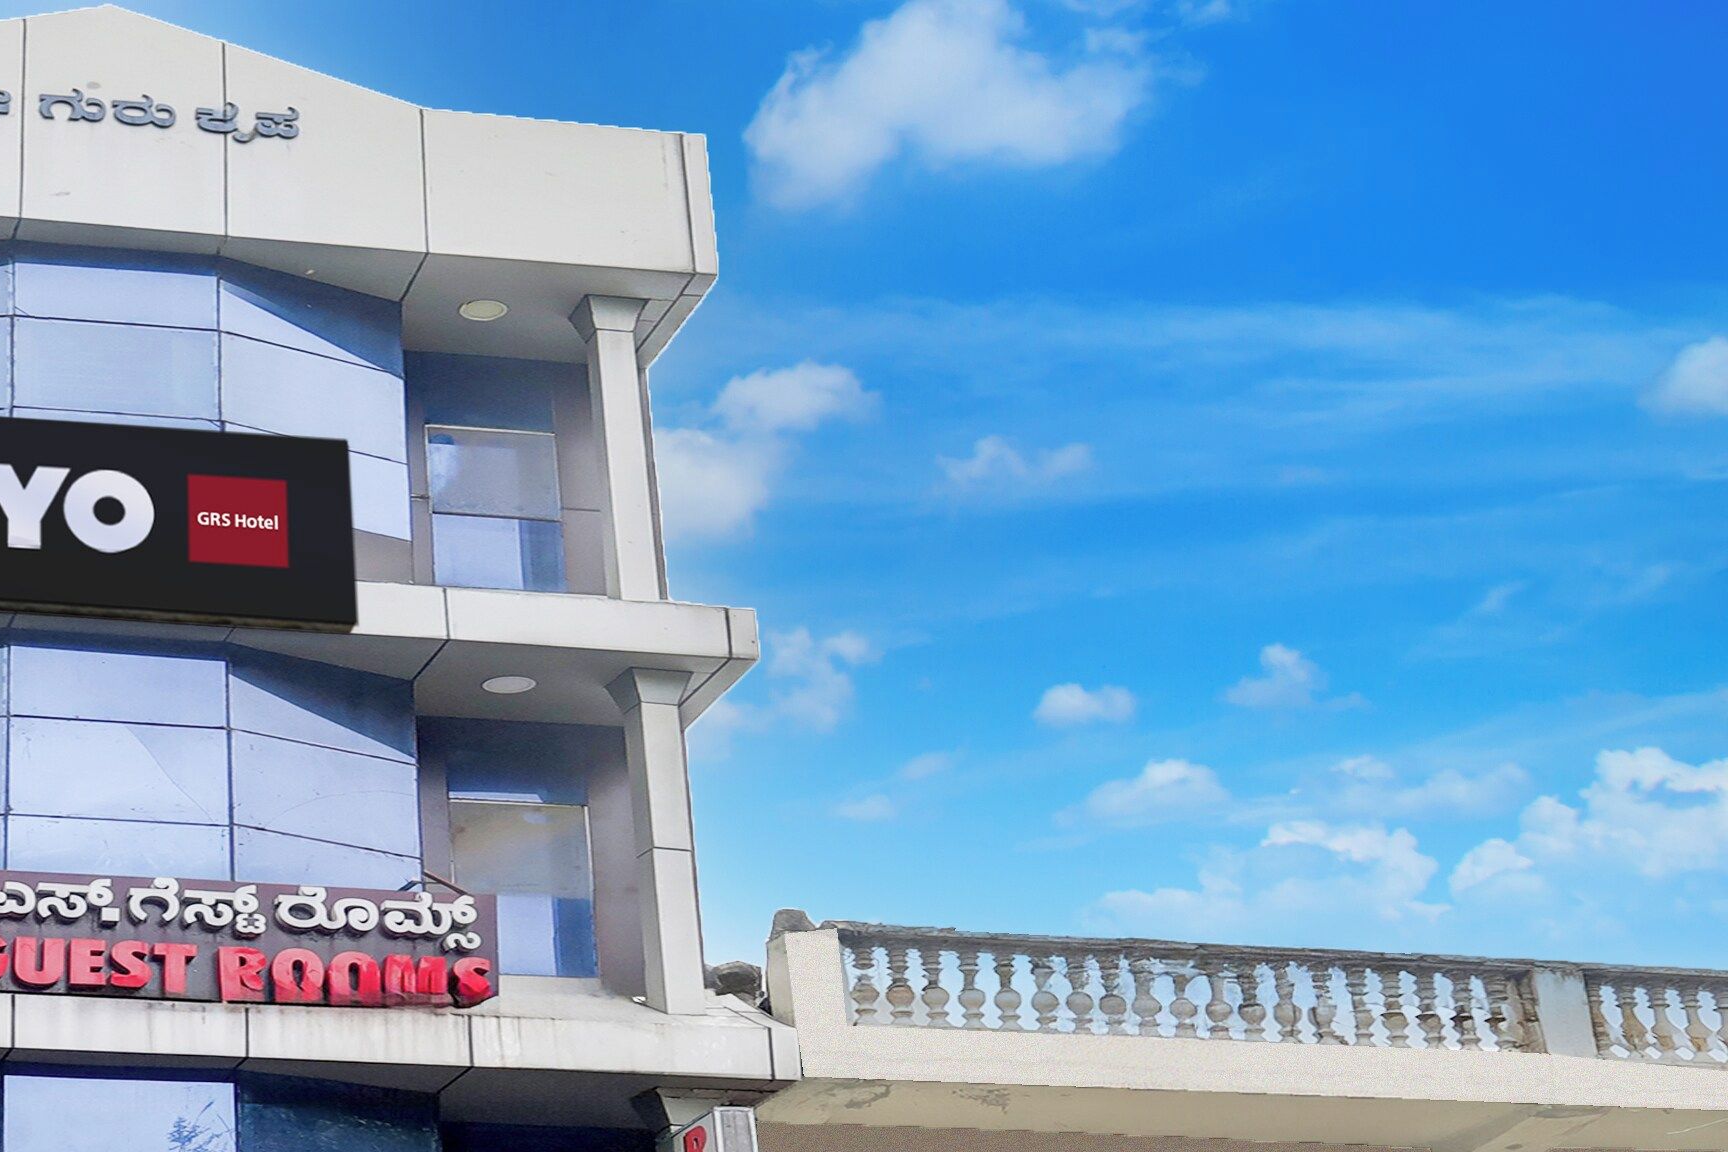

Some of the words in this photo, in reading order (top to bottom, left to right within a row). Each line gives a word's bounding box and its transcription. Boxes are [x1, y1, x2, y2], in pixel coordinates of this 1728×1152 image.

[38, 87, 177, 129] ಗುರು
[196, 511, 232, 528] GRS
[233, 513, 279, 531] Hotel
[218, 945, 493, 1008] ROOMS
